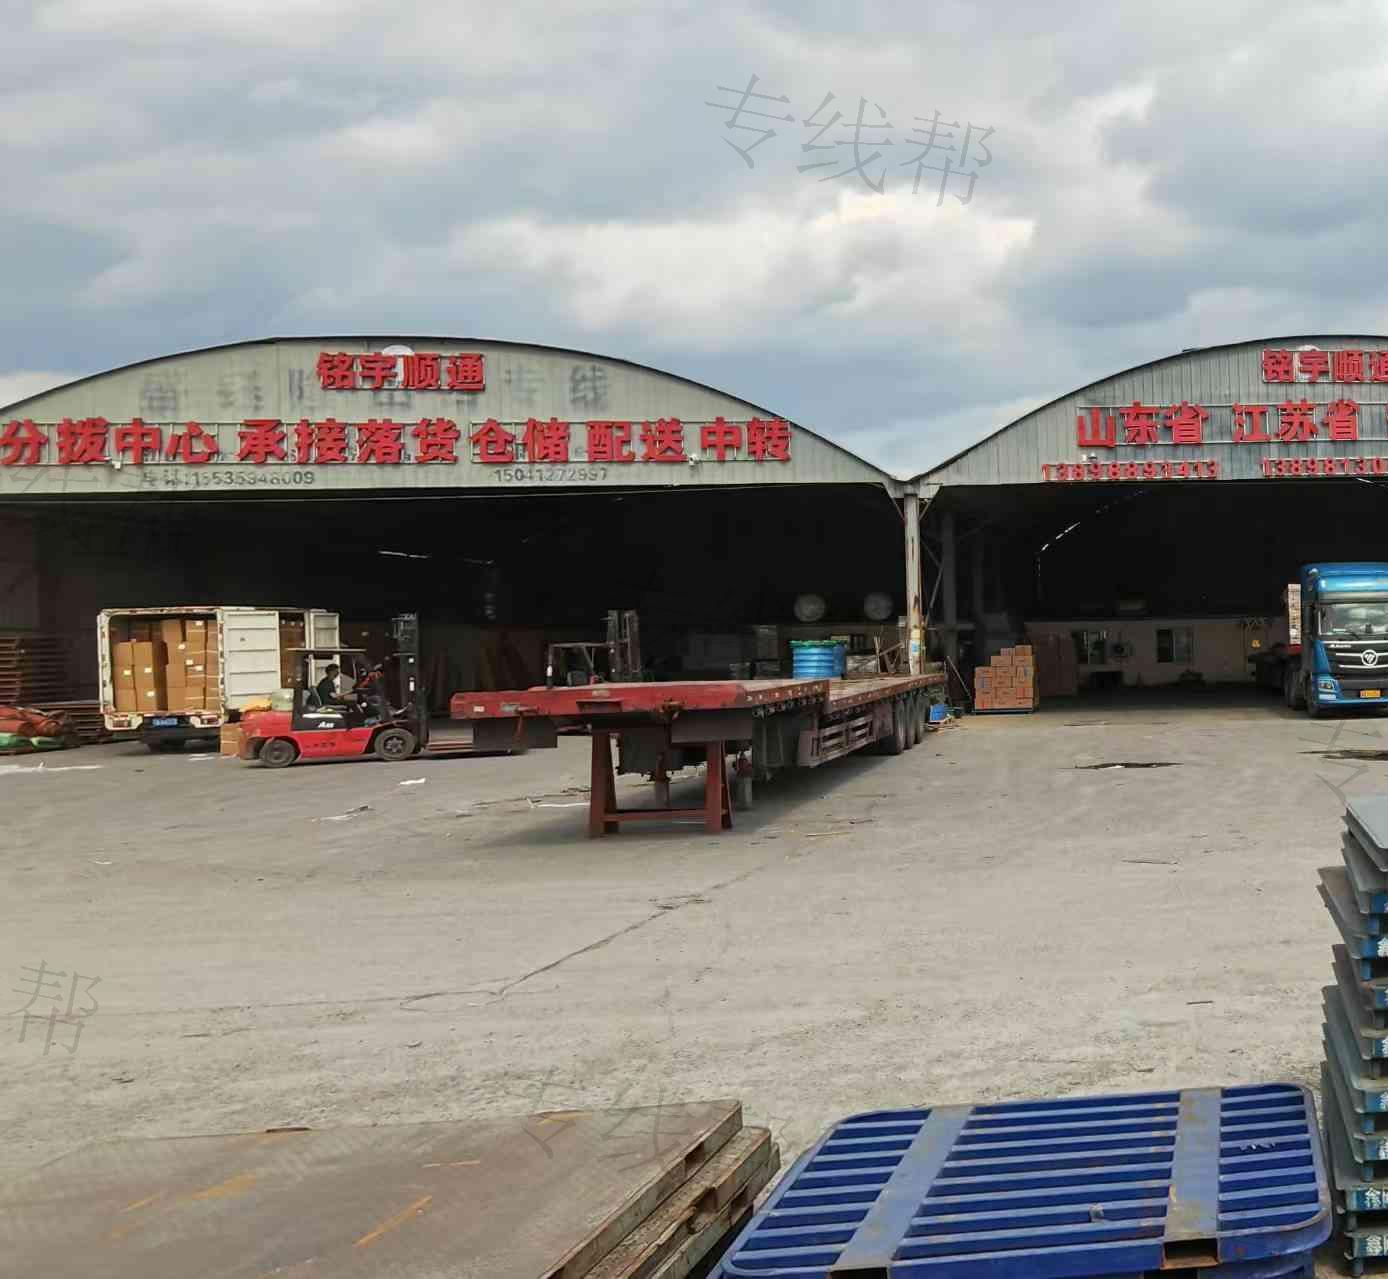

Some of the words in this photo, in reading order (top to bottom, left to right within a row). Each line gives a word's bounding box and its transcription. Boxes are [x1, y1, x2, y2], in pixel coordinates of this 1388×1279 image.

[317, 352, 486, 391] 铭宇顺通
[0, 416, 219, 465] 分拨中心
[700, 416, 793, 464] 中转
[1077, 401, 1208, 448] 山东省
[1232, 399, 1361, 443] 江苏省
